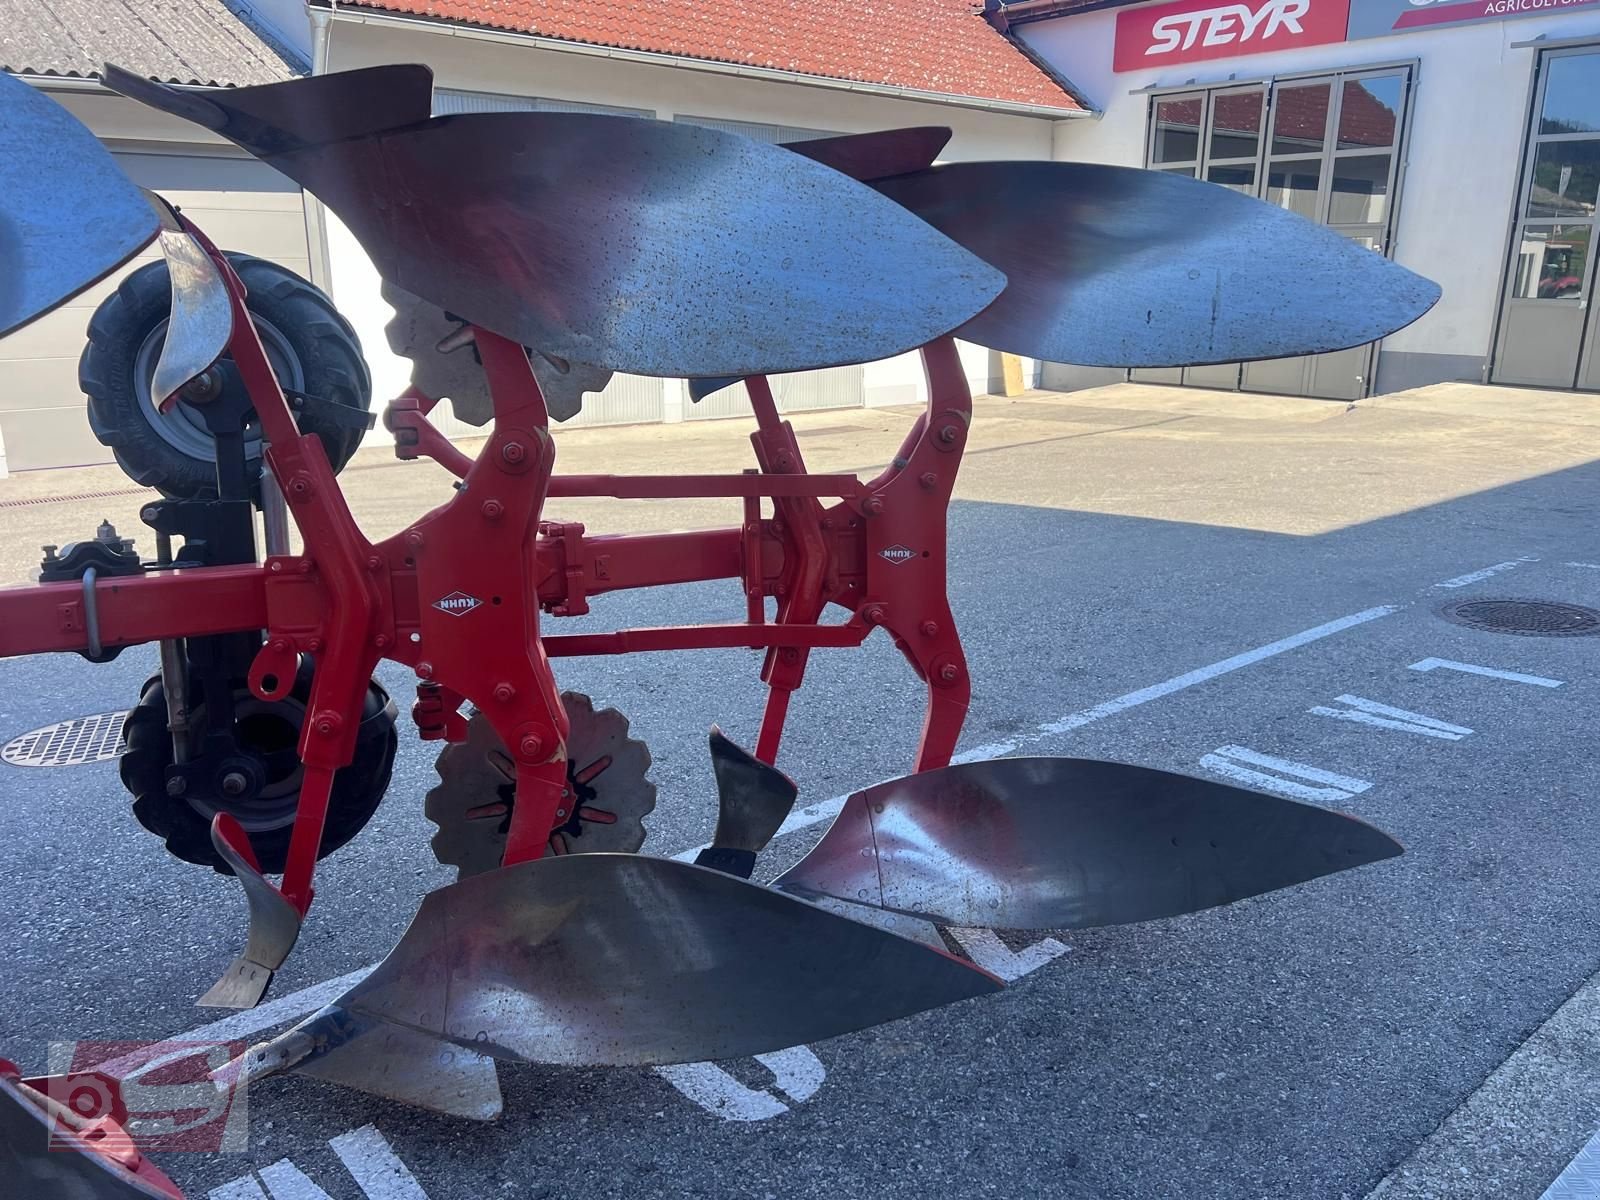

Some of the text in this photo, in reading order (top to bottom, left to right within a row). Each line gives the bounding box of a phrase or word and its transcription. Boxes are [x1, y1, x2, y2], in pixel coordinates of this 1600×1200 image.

[1144, 0, 1310, 56] STEYR
[884, 550, 910, 558] KUHN
[440, 598, 475, 609] KUHN
